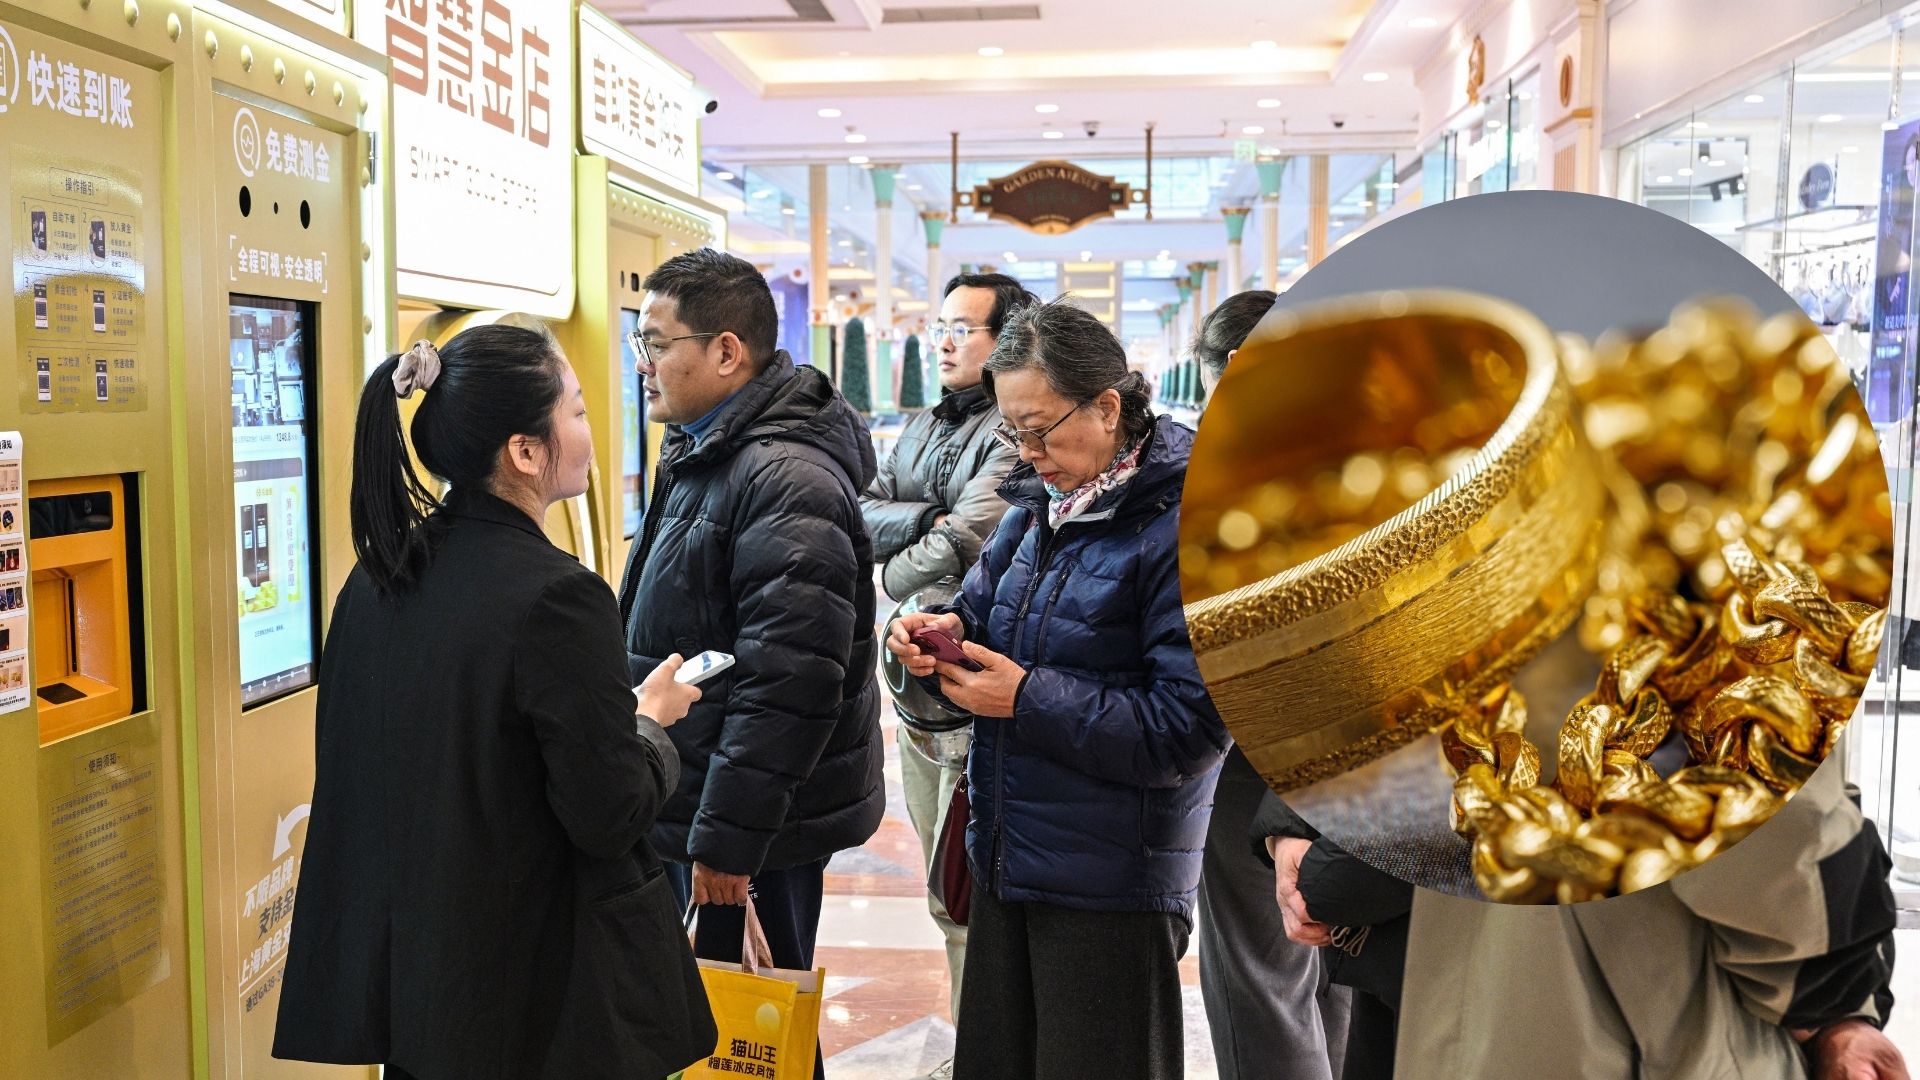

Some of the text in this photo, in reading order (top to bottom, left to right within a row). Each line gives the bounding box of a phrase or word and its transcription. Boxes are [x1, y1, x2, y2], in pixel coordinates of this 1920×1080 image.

[27, 50, 134, 128] 快速到账
[266, 128, 330, 183] 免费测金
[65, 177, 94, 196] 操作指引
[1003, 167, 1055, 193] GARDEN
[238, 246, 323, 283] 全程可视·安全透明
[88, 752, 117, 773] 使用须知
[242, 855, 295, 918] 不限品牌
[730, 1038, 777, 1064] 猫山王
[707, 1056, 776, 1080] 榴莲冰皮月饼
